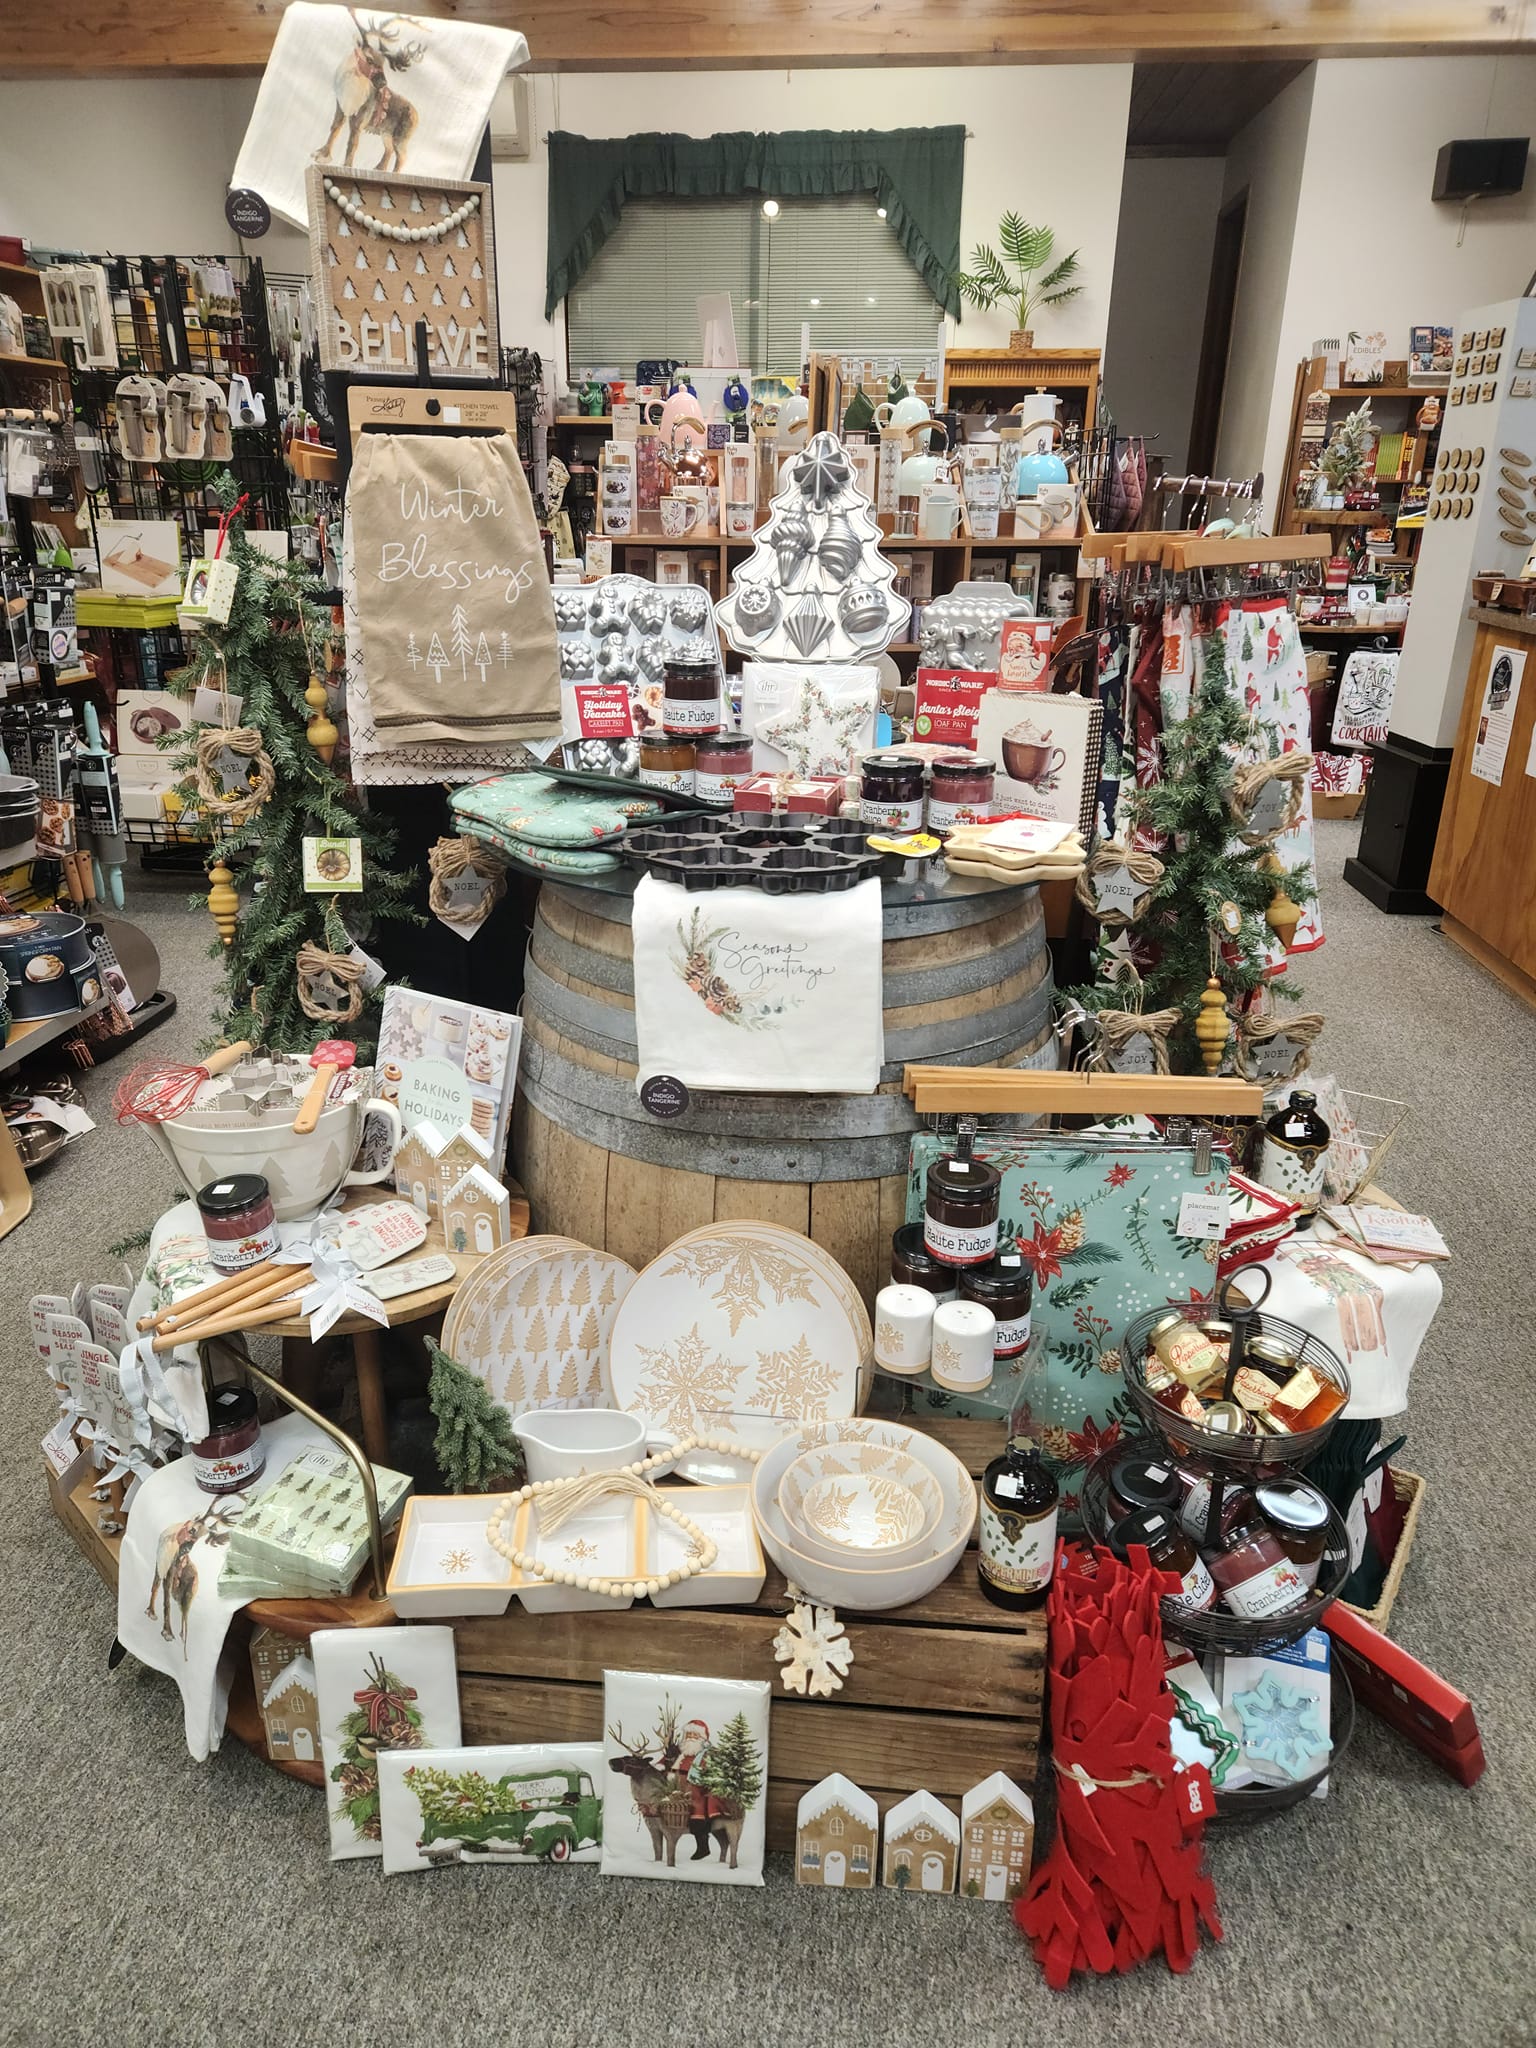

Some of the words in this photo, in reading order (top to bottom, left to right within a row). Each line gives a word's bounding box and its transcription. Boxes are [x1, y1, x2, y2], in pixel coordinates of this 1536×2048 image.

[401, 475, 503, 523] Winter
[378, 533, 533, 603] Blessings
[926, 679, 950, 687] NORDIC
[583, 700, 624, 711] Holiday
[918, 702, 953, 715] Santa's
[952, 704, 980, 720] Sleig
[583, 709, 627, 719] Teacakes
[688, 710, 715, 723] Fudge
[934, 719, 950, 728] LOAF
[952, 721, 967, 729] PAN
[1338, 724, 1389, 743] COCKTAILS
[221, 762, 242, 774] NOEL
[671, 780, 692, 792] Cider
[863, 802, 902, 817] Cranberry
[1037, 801, 1057, 811] drink
[1261, 803, 1277, 814] JOY
[864, 813, 882, 824] Sauce
[930, 813, 969, 826] Cranberry
[1040, 811, 1058, 819] watch
[454, 881, 480, 891] NOEL
[1104, 883, 1133, 897] NOEL
[718, 931, 808, 969] Seasons
[740, 955, 836, 990] Greetings
[314, 981, 337, 998] NOEL
[1127, 1055, 1148, 1065] JOY
[1263, 1049, 1290, 1060] NOEL
[413, 1079, 461, 1103] BAKING
[652, 1092, 675, 1100] INDIGO
[648, 1096, 681, 1105] TANGERINE
[404, 1100, 463, 1128] HOLIDAYS
[1187, 1202, 1220, 1211] placemat
[927, 1226, 955, 1249] Haute
[958, 1238, 991, 1251] Fudge
[98, 1288, 116, 1297] Have
[95, 1315, 120, 1329] REASON
[52, 1328, 82, 1338] REASON
[97, 1327, 121, 1342] SEASON
[996, 1328, 1027, 1344] Fudge
[54, 1342, 75, 1350] SEAS
[81, 1350, 110, 1363] JINGLE
[85, 1376, 100, 1387] JING
[1247, 1582, 1296, 1613] Cranberry
